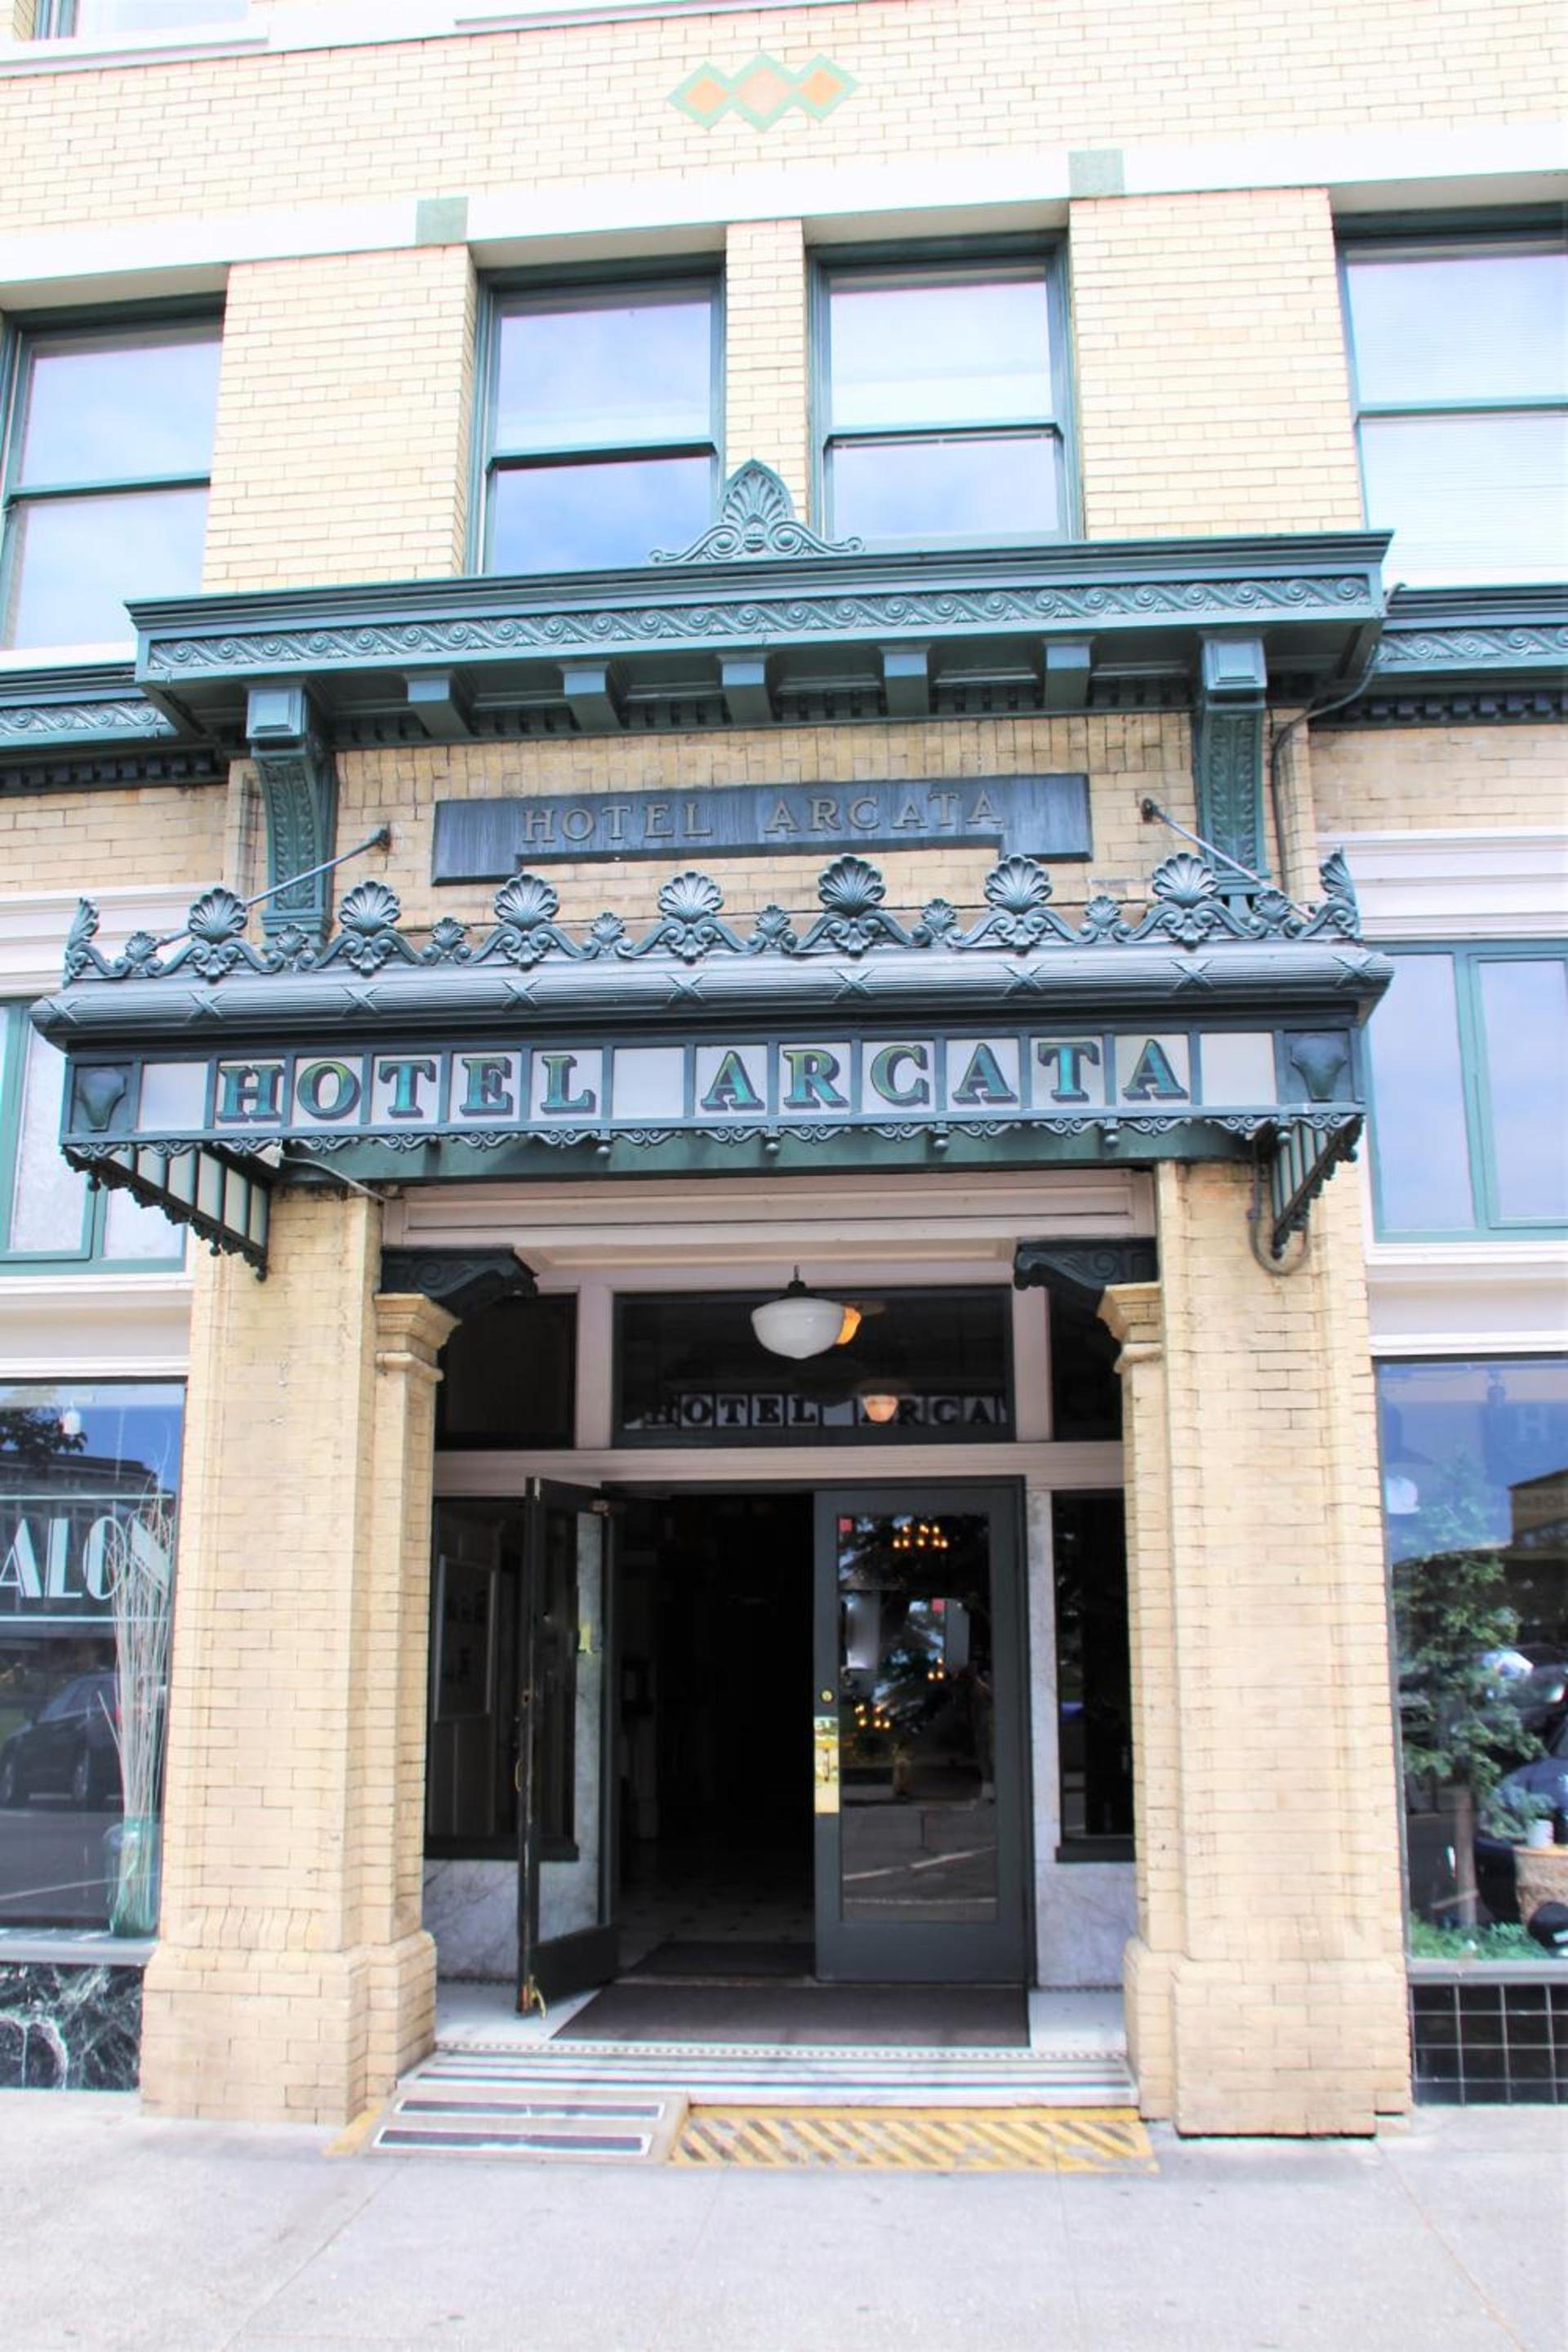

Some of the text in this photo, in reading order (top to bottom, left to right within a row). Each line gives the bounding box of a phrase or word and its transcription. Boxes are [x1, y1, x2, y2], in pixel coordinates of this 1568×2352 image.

[522, 791, 1004, 844] HOTEL ARCATA
[216, 1038, 1187, 1122] HOTEL ARCATA
